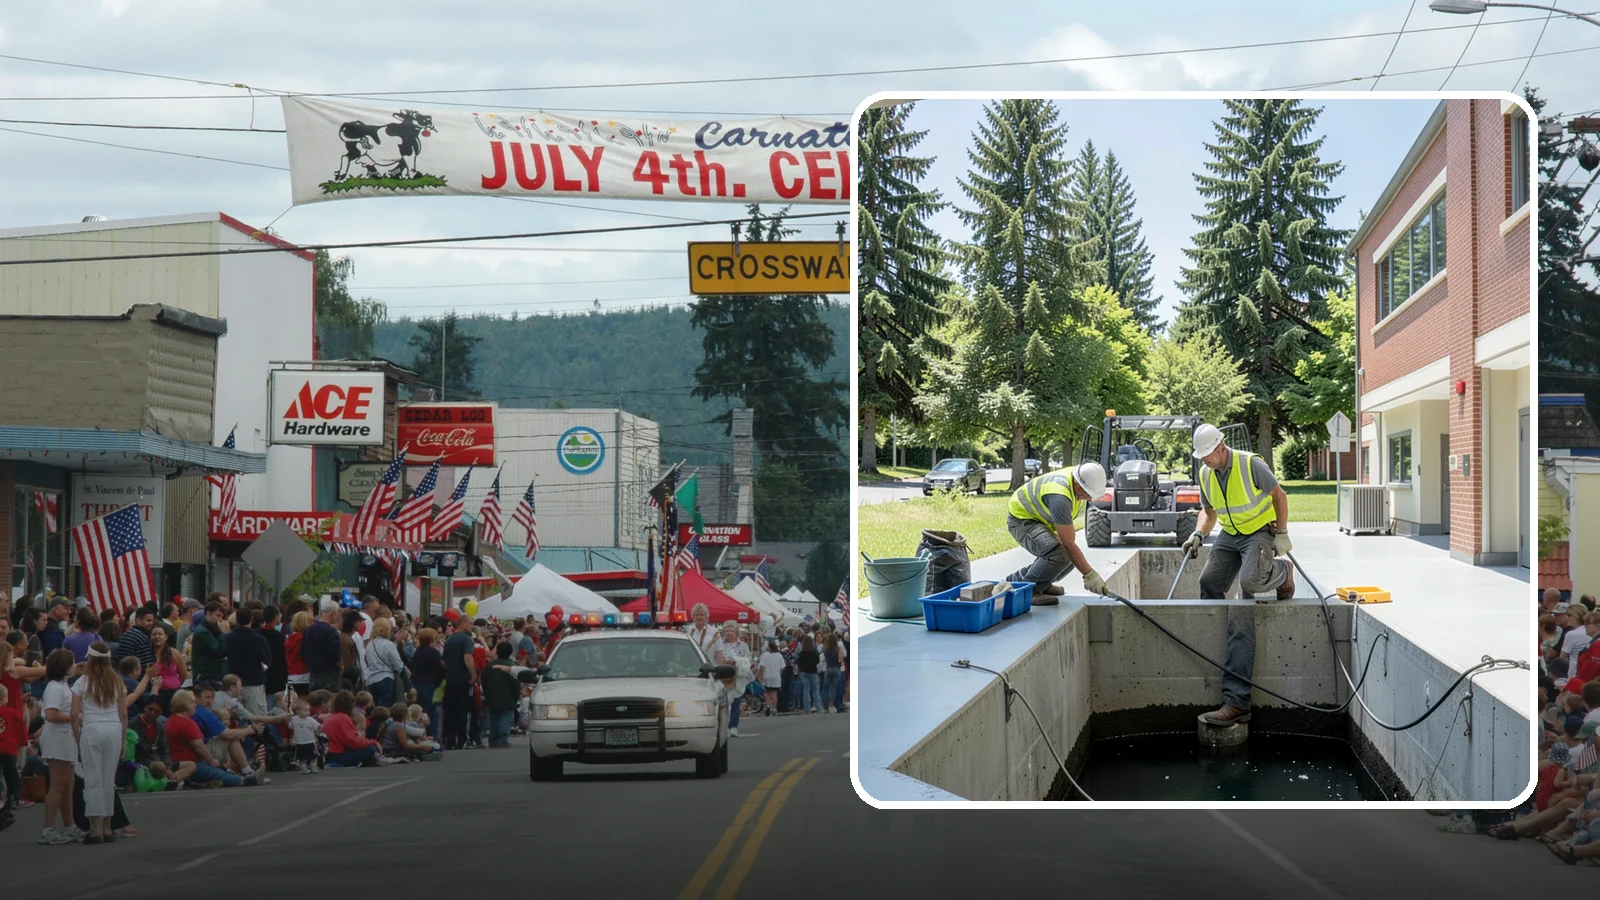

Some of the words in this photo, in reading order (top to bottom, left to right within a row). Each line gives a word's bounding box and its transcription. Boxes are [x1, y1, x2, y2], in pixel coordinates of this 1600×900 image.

[481, 141, 605, 192] JULY
[632, 150, 746, 198] 4th.
[697, 255, 850, 280] CROSSWA
[282, 380, 374, 420] ACE
[405, 409, 453, 422] CEDAR
[461, 409, 485, 421] LOG
[283, 421, 371, 436] Hardware
[416, 428, 477, 447] Coca-Cola
[353, 467, 385, 480] Simpl
[95, 485, 124, 494] Vincent
[126, 486, 136, 494] de
[137, 486, 155, 495] Paul
[80, 503, 154, 522] THT
[212, 516, 331, 535] HARDARE
[688, 526, 741, 535] CRNATION
[699, 535, 730, 543] GLASS
